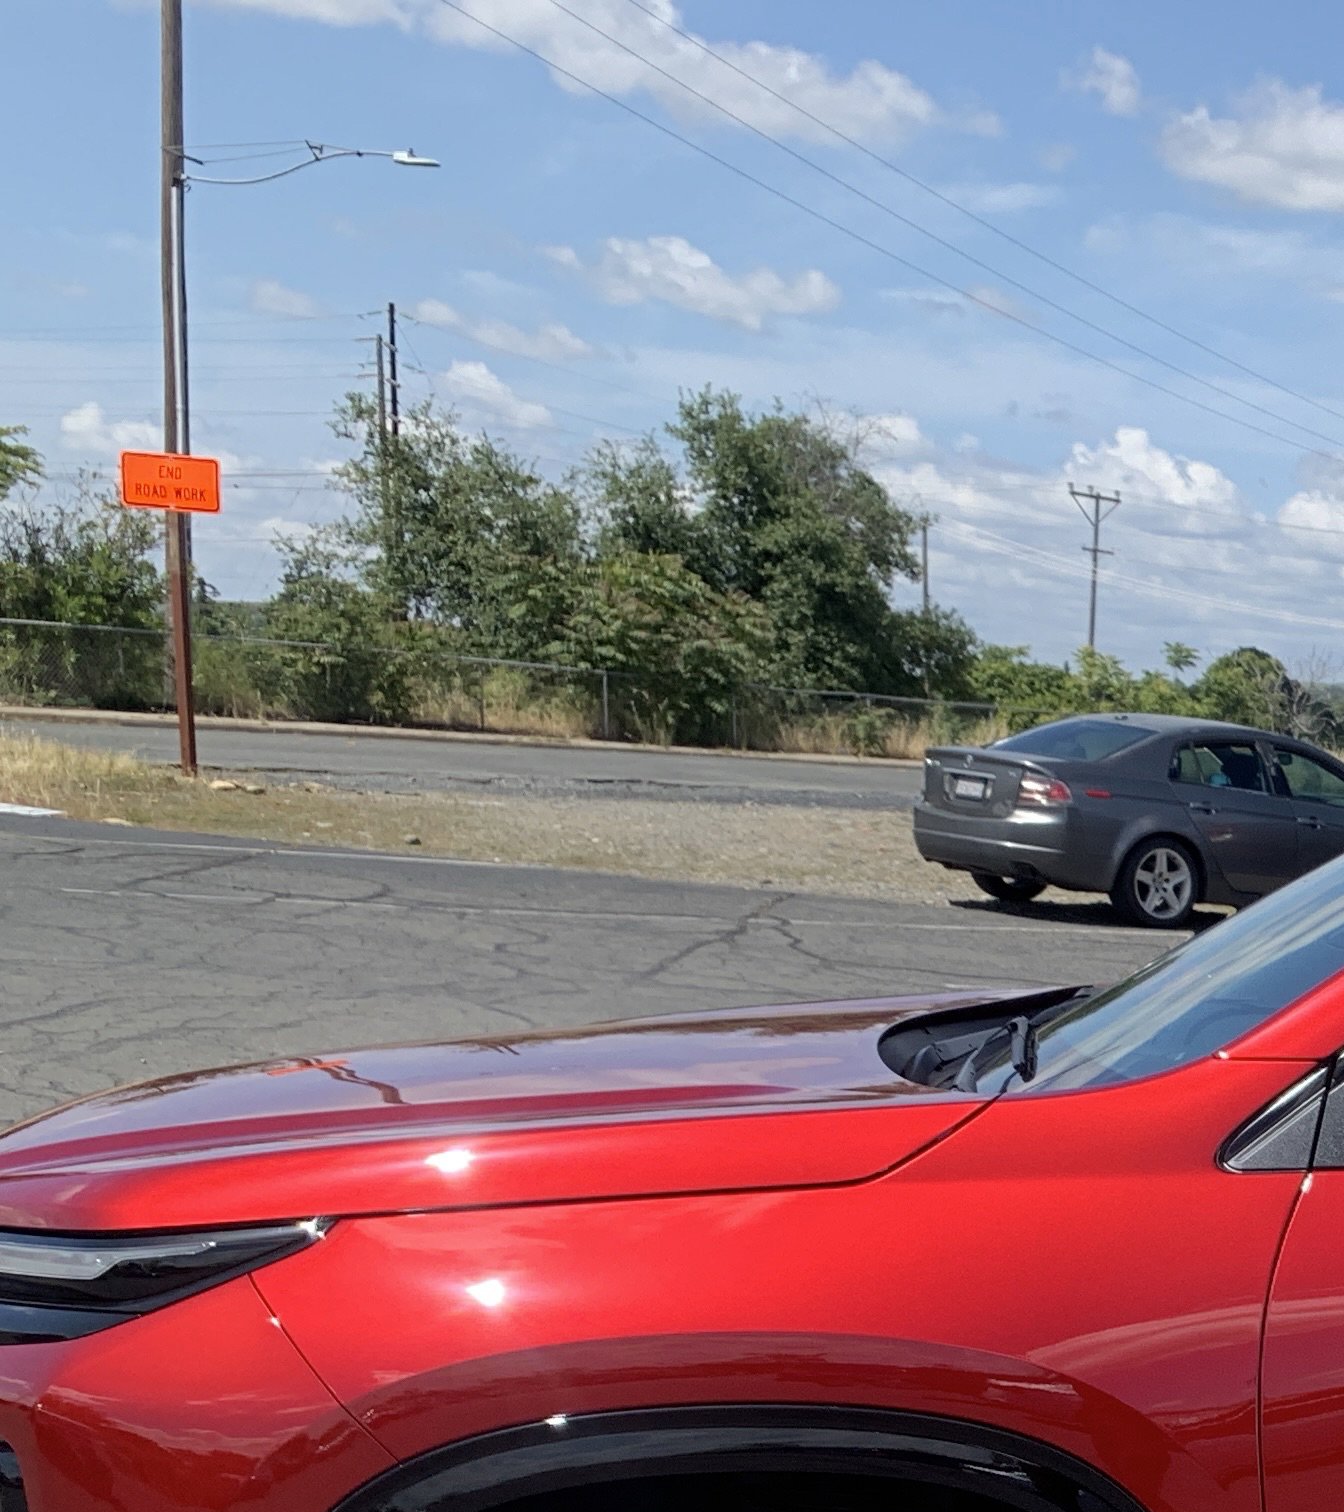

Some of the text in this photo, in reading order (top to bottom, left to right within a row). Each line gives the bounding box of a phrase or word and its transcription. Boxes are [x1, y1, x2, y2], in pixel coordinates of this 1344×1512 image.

[158, 465, 182, 480] END
[135, 483, 206, 502] ROAD WORK
